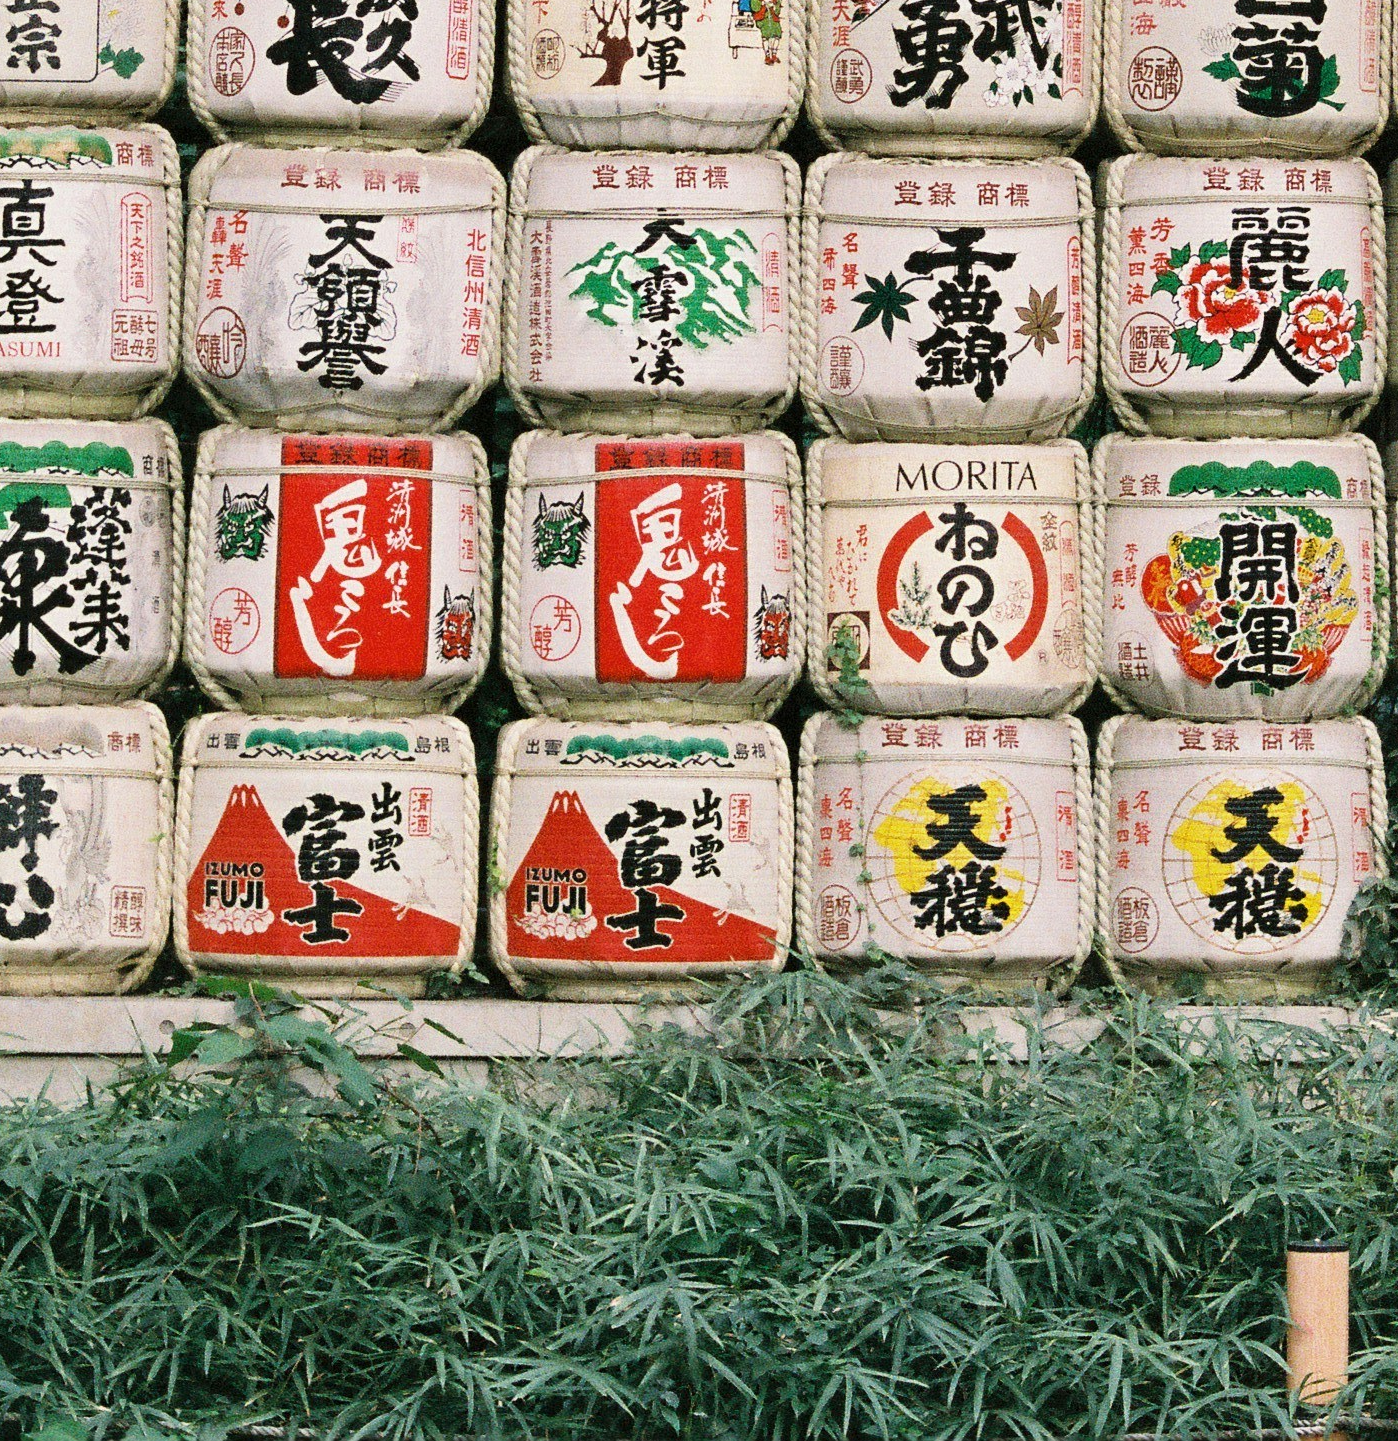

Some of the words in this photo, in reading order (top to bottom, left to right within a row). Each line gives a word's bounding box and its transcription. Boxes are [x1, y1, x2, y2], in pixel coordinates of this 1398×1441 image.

[128, 203, 145, 288] 天下之銘酒
[1151, 219, 1175, 272] 芳香
[461, 230, 486, 356] 北信州清酒
[905, 228, 1021, 402] 千曲錦
[1229, 206, 1323, 386] 麗人
[897, 460, 1037, 492] MORITA
[292, 480, 382, 675] 鬼ころし
[611, 484, 701, 676] 鬼ころし
[932, 502, 999, 678] ねのひ
[1214, 509, 1313, 690] 開運
[207, 732, 239, 749] 出雲
[416, 735, 451, 754] 島根
[525, 738, 561, 755] 出雲
[735, 742, 767, 758] 島根
[369, 782, 404, 873] 出雲
[412, 790, 430, 834] 清酒
[691, 789, 723, 878] 出雲
[731, 795, 748, 840] 清酒
[206, 863, 264, 876] IZUMO
[206, 879, 264, 909] FUJI
[283, 794, 364, 943] 富士
[527, 868, 587, 882] IZUMO
[527, 884, 587, 915] FUJI
[605, 800, 685, 950] 富士
